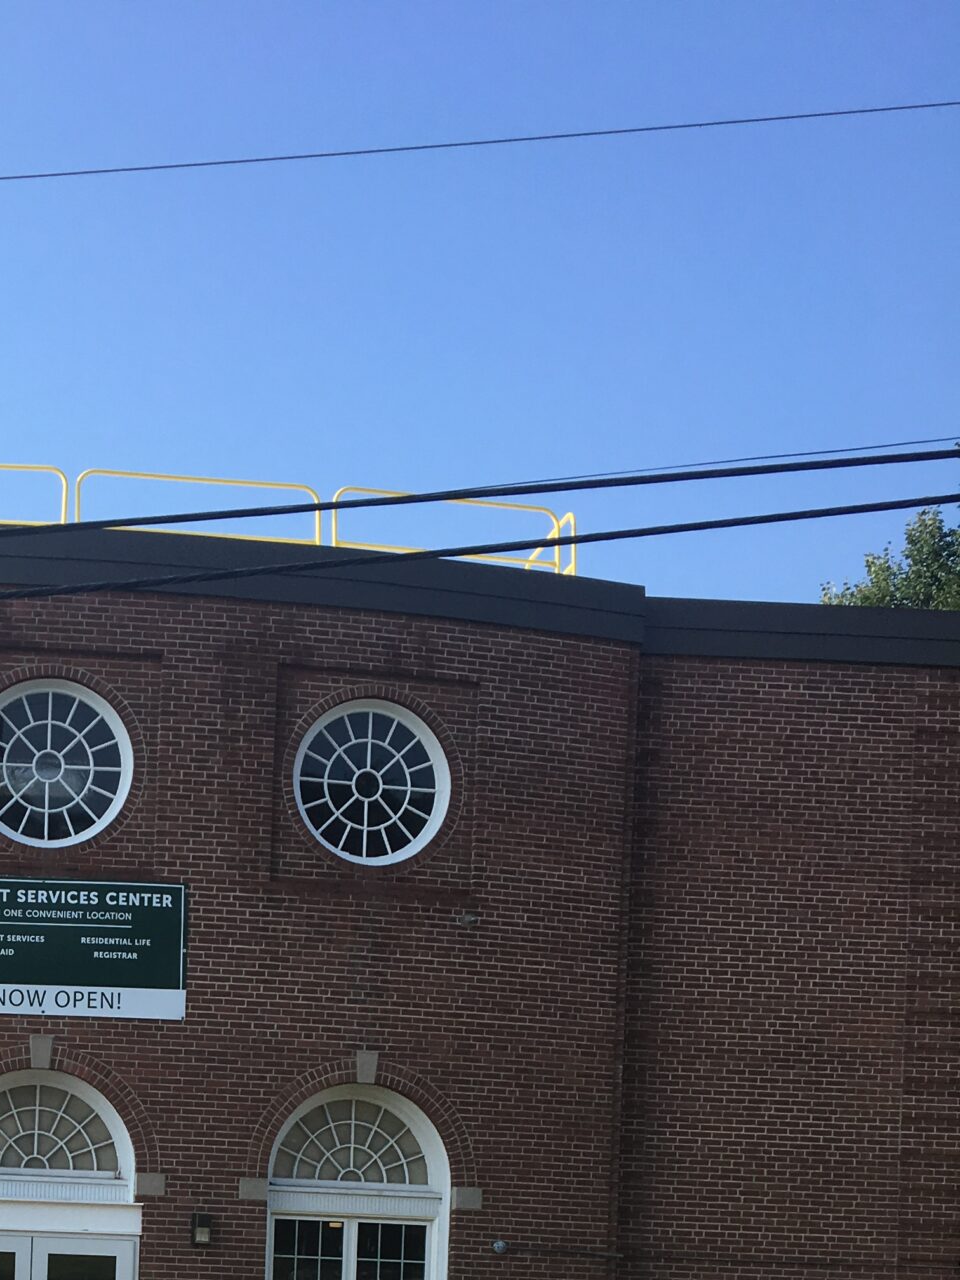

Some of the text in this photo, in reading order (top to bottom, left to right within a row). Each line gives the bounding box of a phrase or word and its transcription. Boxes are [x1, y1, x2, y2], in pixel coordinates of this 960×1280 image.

[16, 889, 99, 905] SERVICES
[105, 892, 173, 908] CENTER
[3, 909, 23, 918] ONE
[25, 909, 84, 919] CONVENIENT
[86, 911, 132, 921] LOCATION
[6, 935, 46, 943] SERVICES
[80, 937, 151, 947] RESIDENTIAL LIFE
[0, 948, 15, 956] AID
[93, 951, 138, 960] REGISTRAR
[54, 990, 121, 1010] OPEN!
